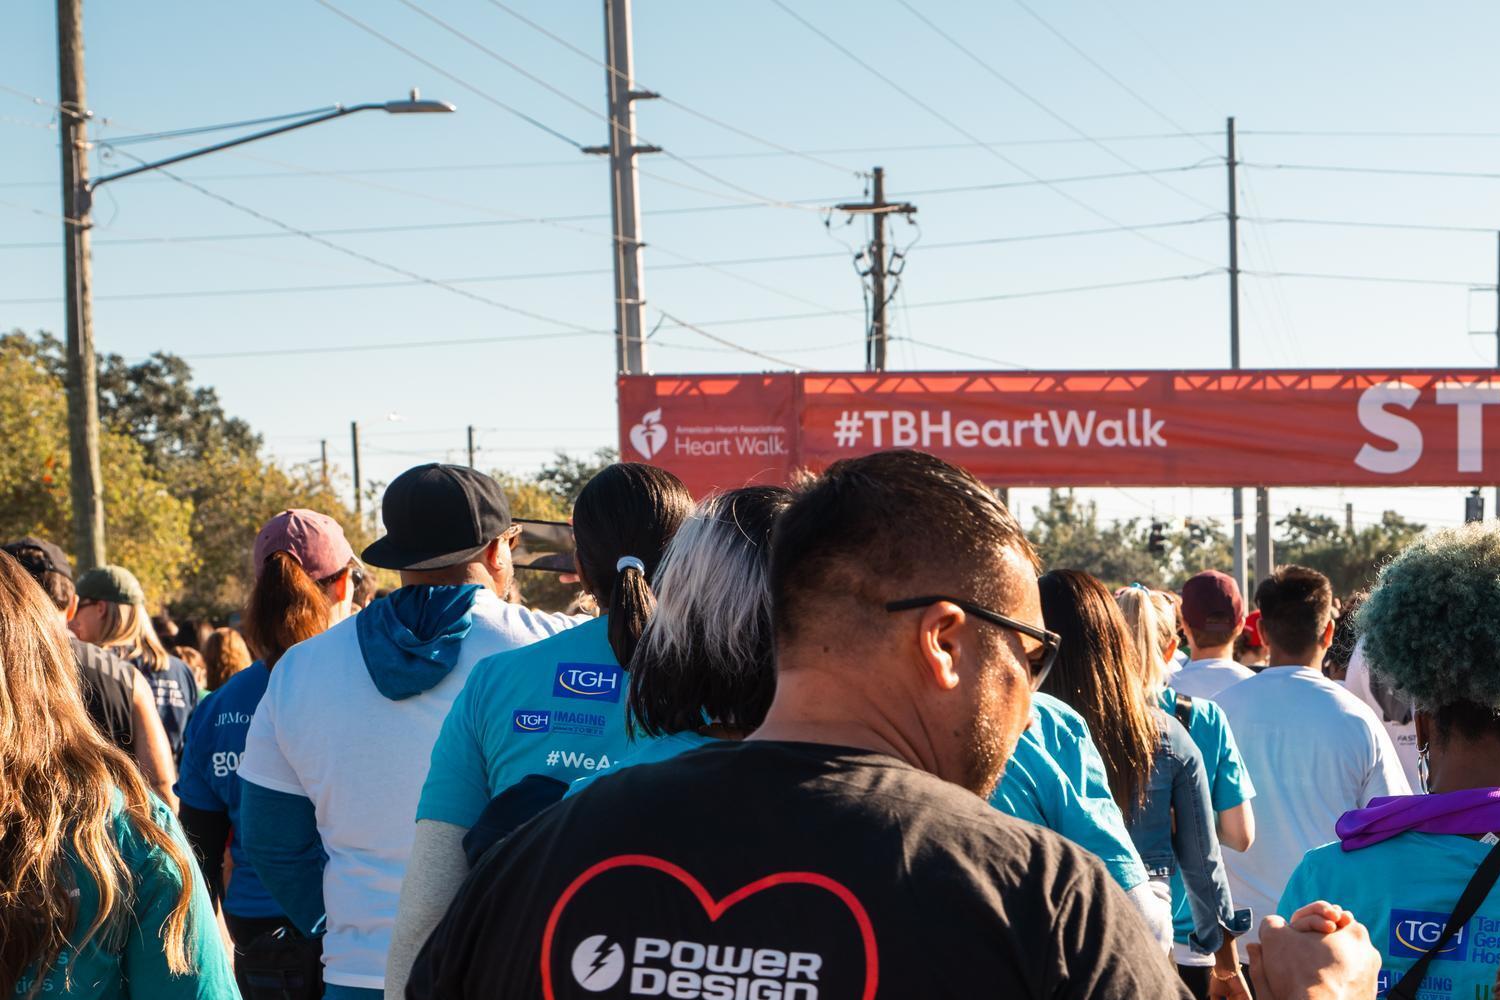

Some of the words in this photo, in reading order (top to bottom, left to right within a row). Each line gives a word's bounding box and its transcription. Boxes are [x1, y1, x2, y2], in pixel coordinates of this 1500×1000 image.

[833, 408, 1167, 448] #TBHeartWalk
[675, 436, 731, 456] Heart
[568, 669, 617, 689] TGH
[521, 714, 548, 725] TGH
[553, 711, 606, 726] IMAGING
